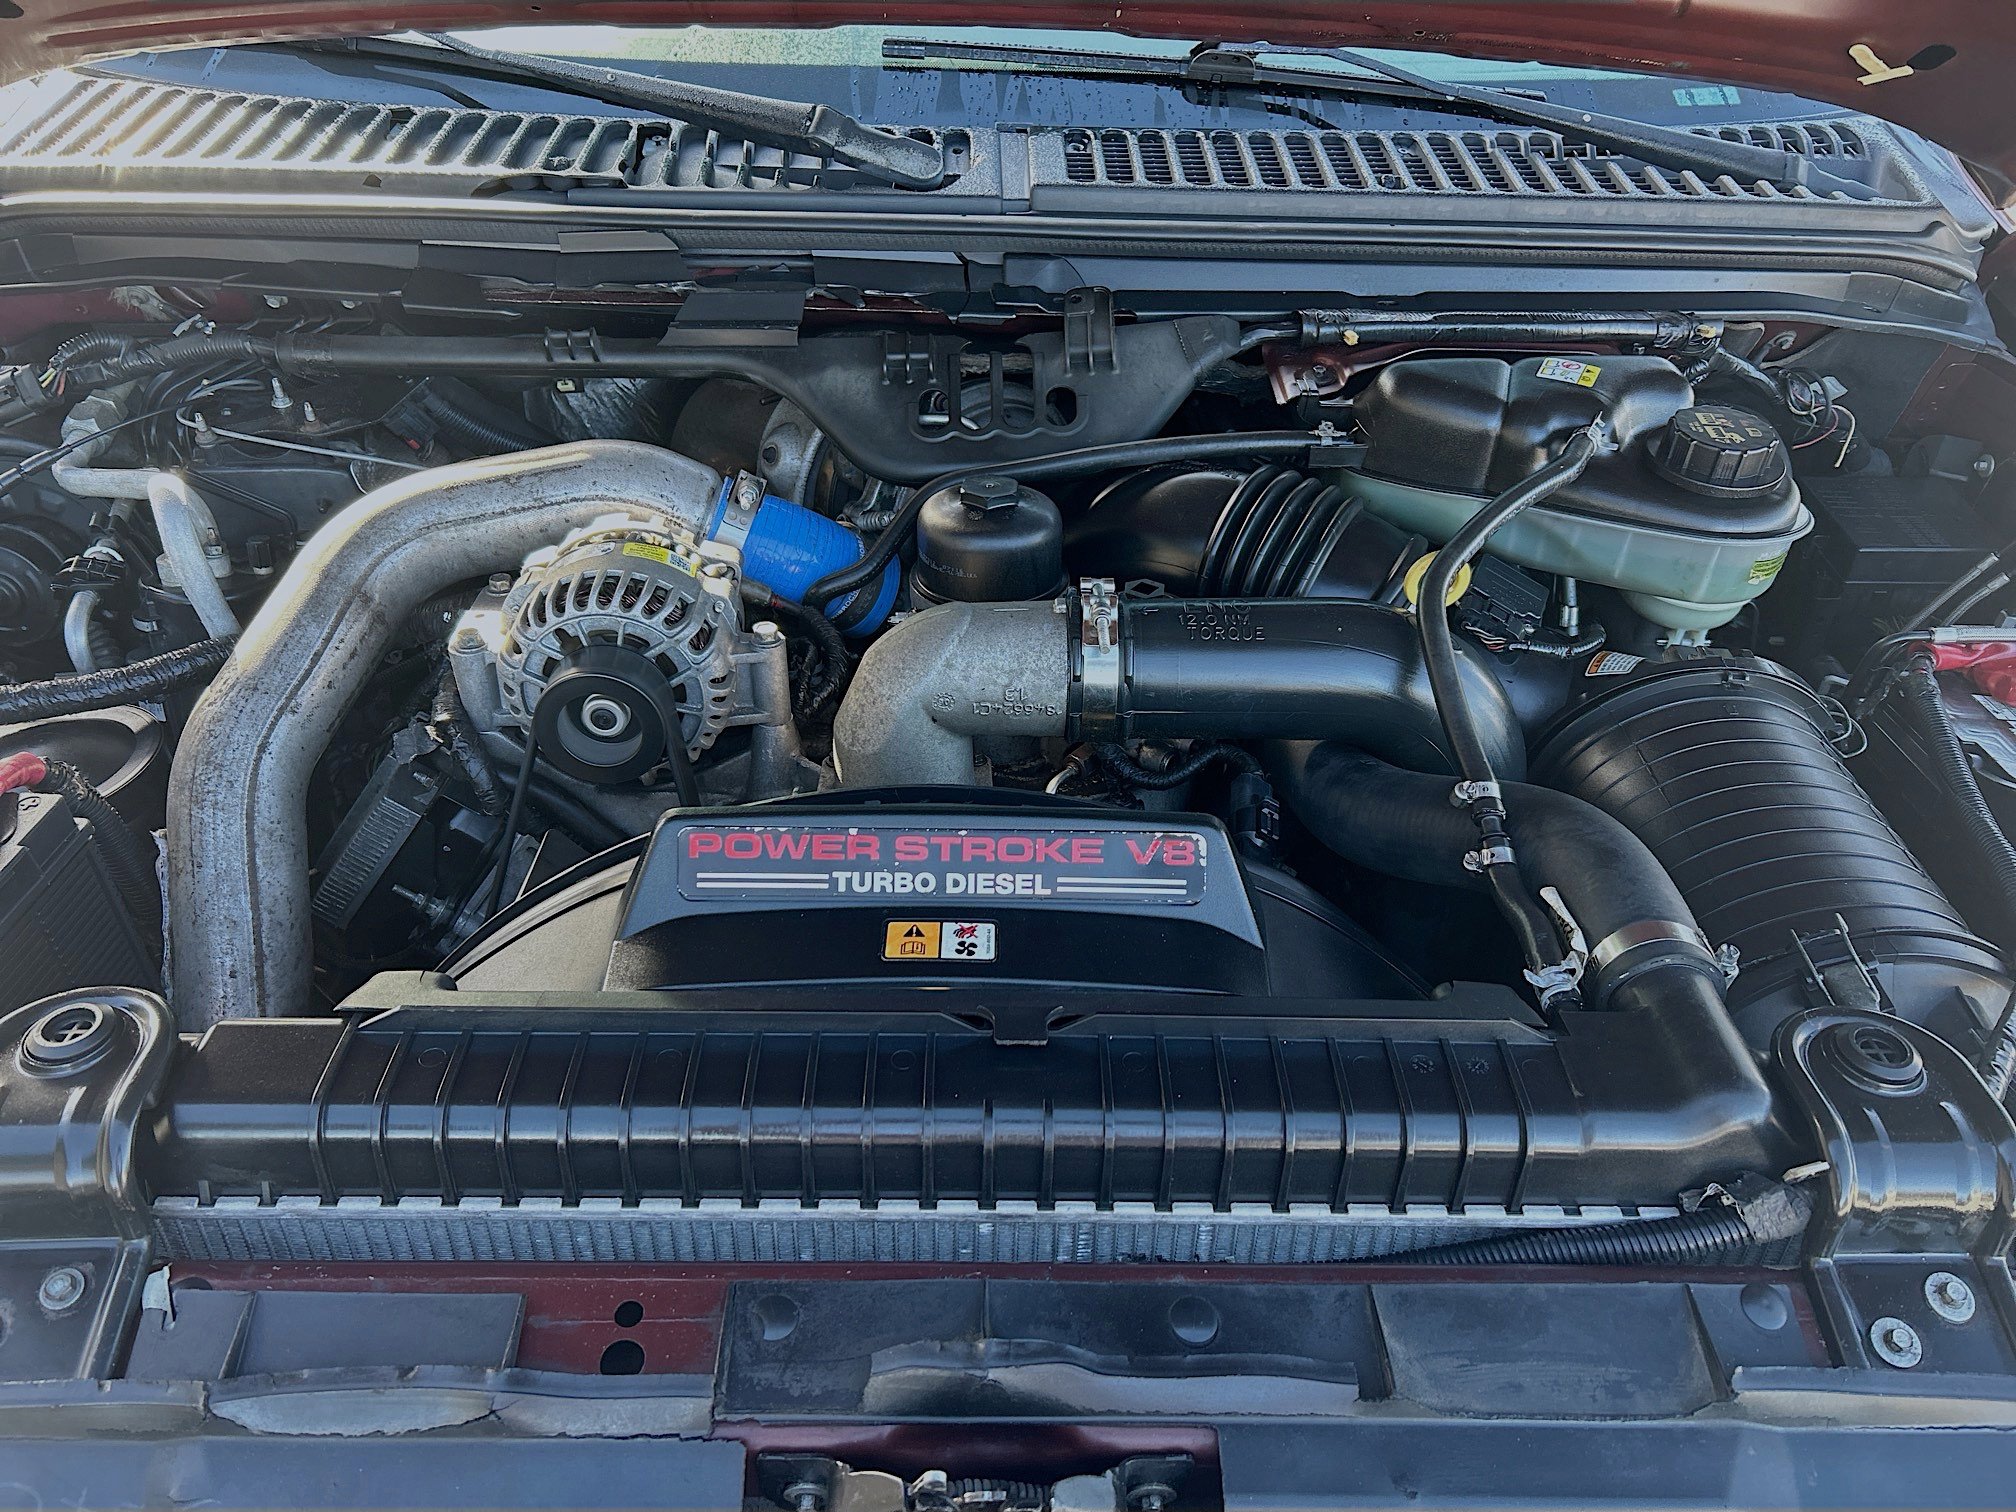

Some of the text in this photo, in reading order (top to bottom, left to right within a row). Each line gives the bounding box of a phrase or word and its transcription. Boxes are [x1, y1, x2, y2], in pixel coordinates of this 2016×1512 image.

[1178, 614, 1218, 626] 12.0
[1186, 626, 1266, 641] TORQUE
[688, 833, 1196, 867] POWER STROKE V8
[831, 871, 1052, 896] TURBO DIESEL
